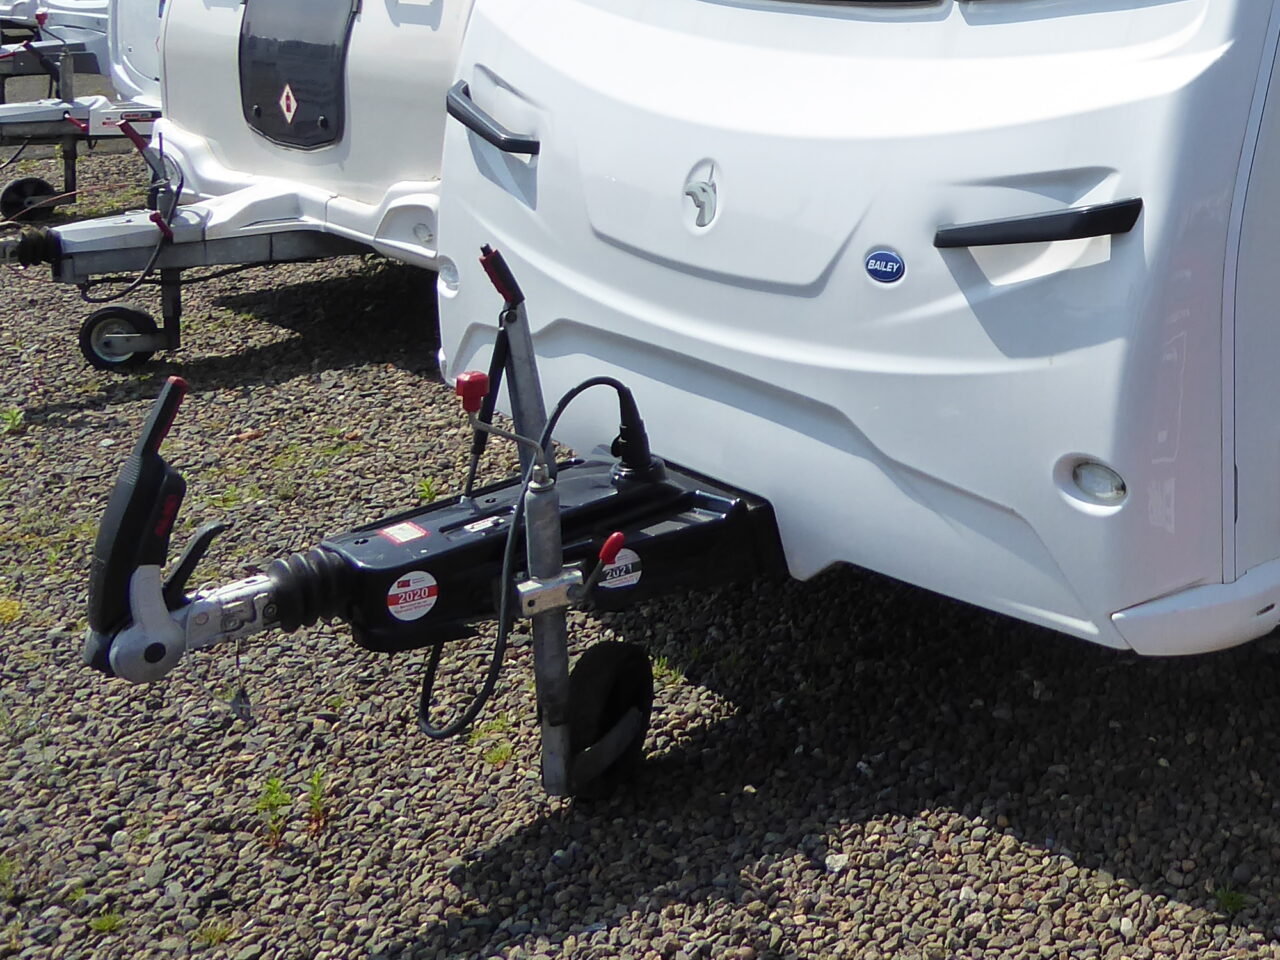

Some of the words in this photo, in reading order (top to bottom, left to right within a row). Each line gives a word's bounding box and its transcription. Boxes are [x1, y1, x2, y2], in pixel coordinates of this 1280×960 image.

[867, 259, 900, 273] BAILEY
[605, 563, 632, 580] 2021
[398, 587, 429, 604] 2020
